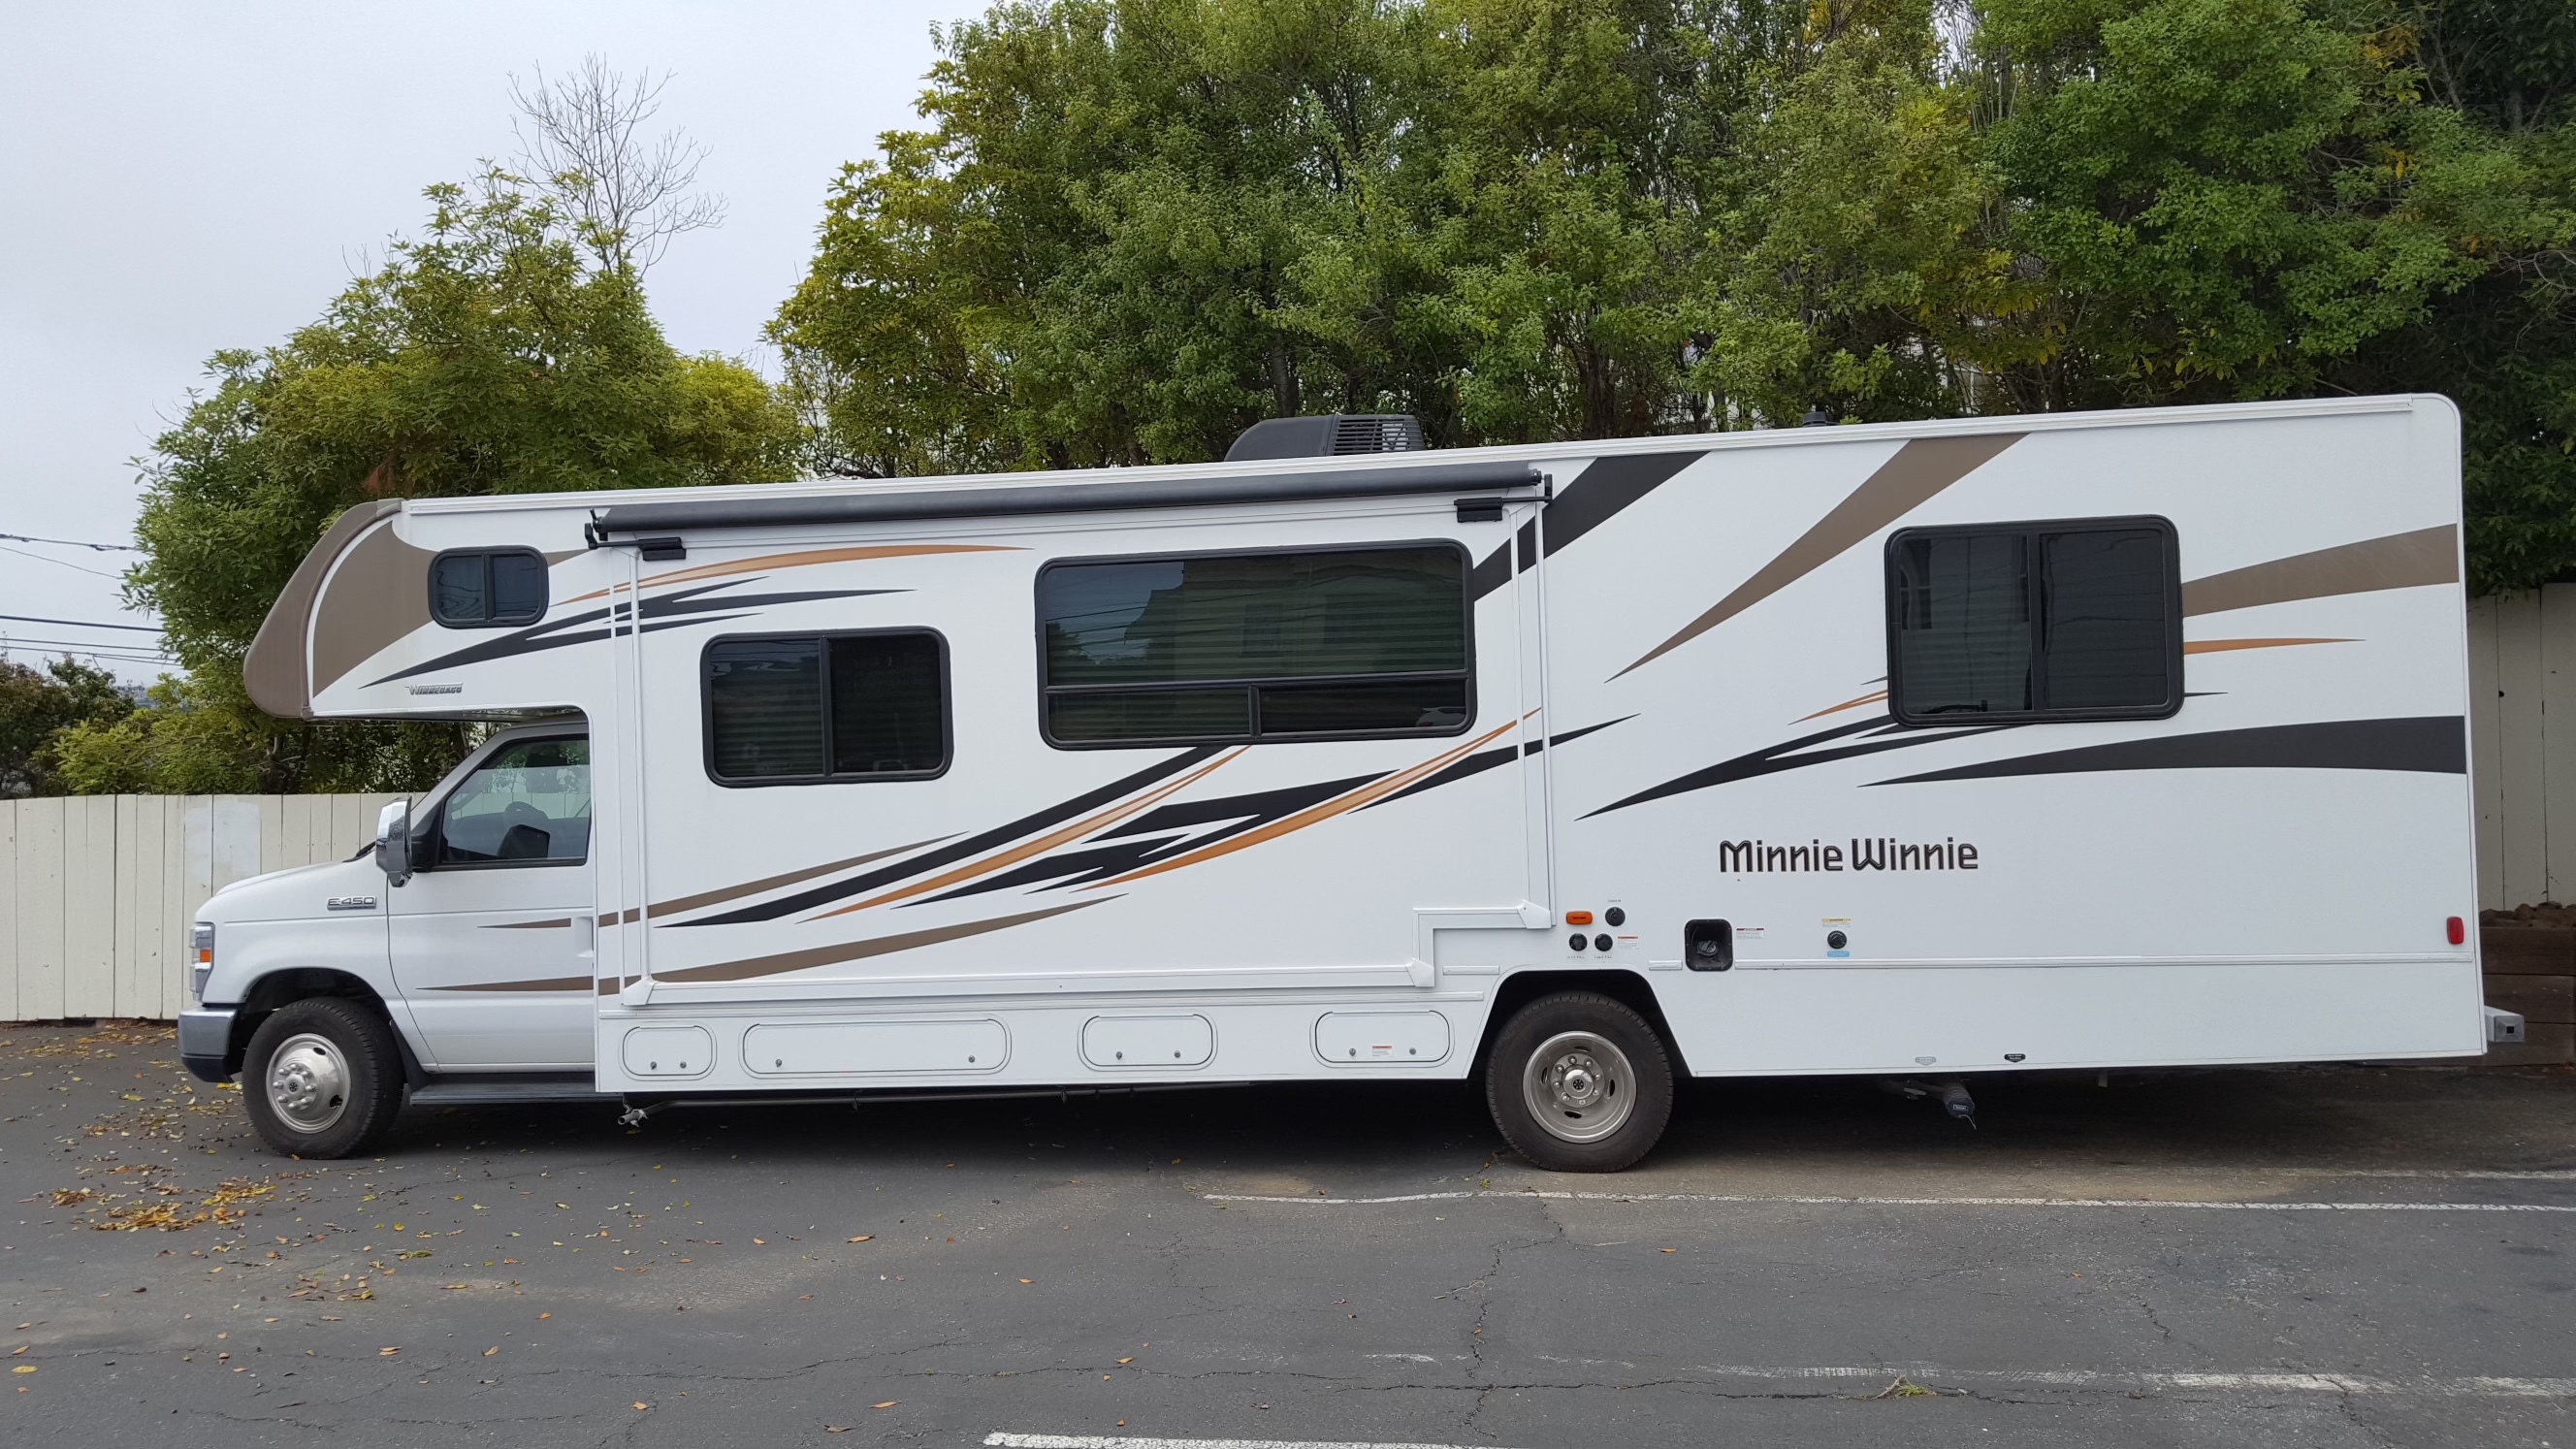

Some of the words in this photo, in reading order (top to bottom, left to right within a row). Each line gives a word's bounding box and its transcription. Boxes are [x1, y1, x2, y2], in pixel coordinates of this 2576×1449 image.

[405, 683, 463, 695] WINNEBAGO
[1720, 839, 1844, 873] Minnie
[1852, 836, 1980, 871] Winnie
[328, 896, 375, 907] E-450
